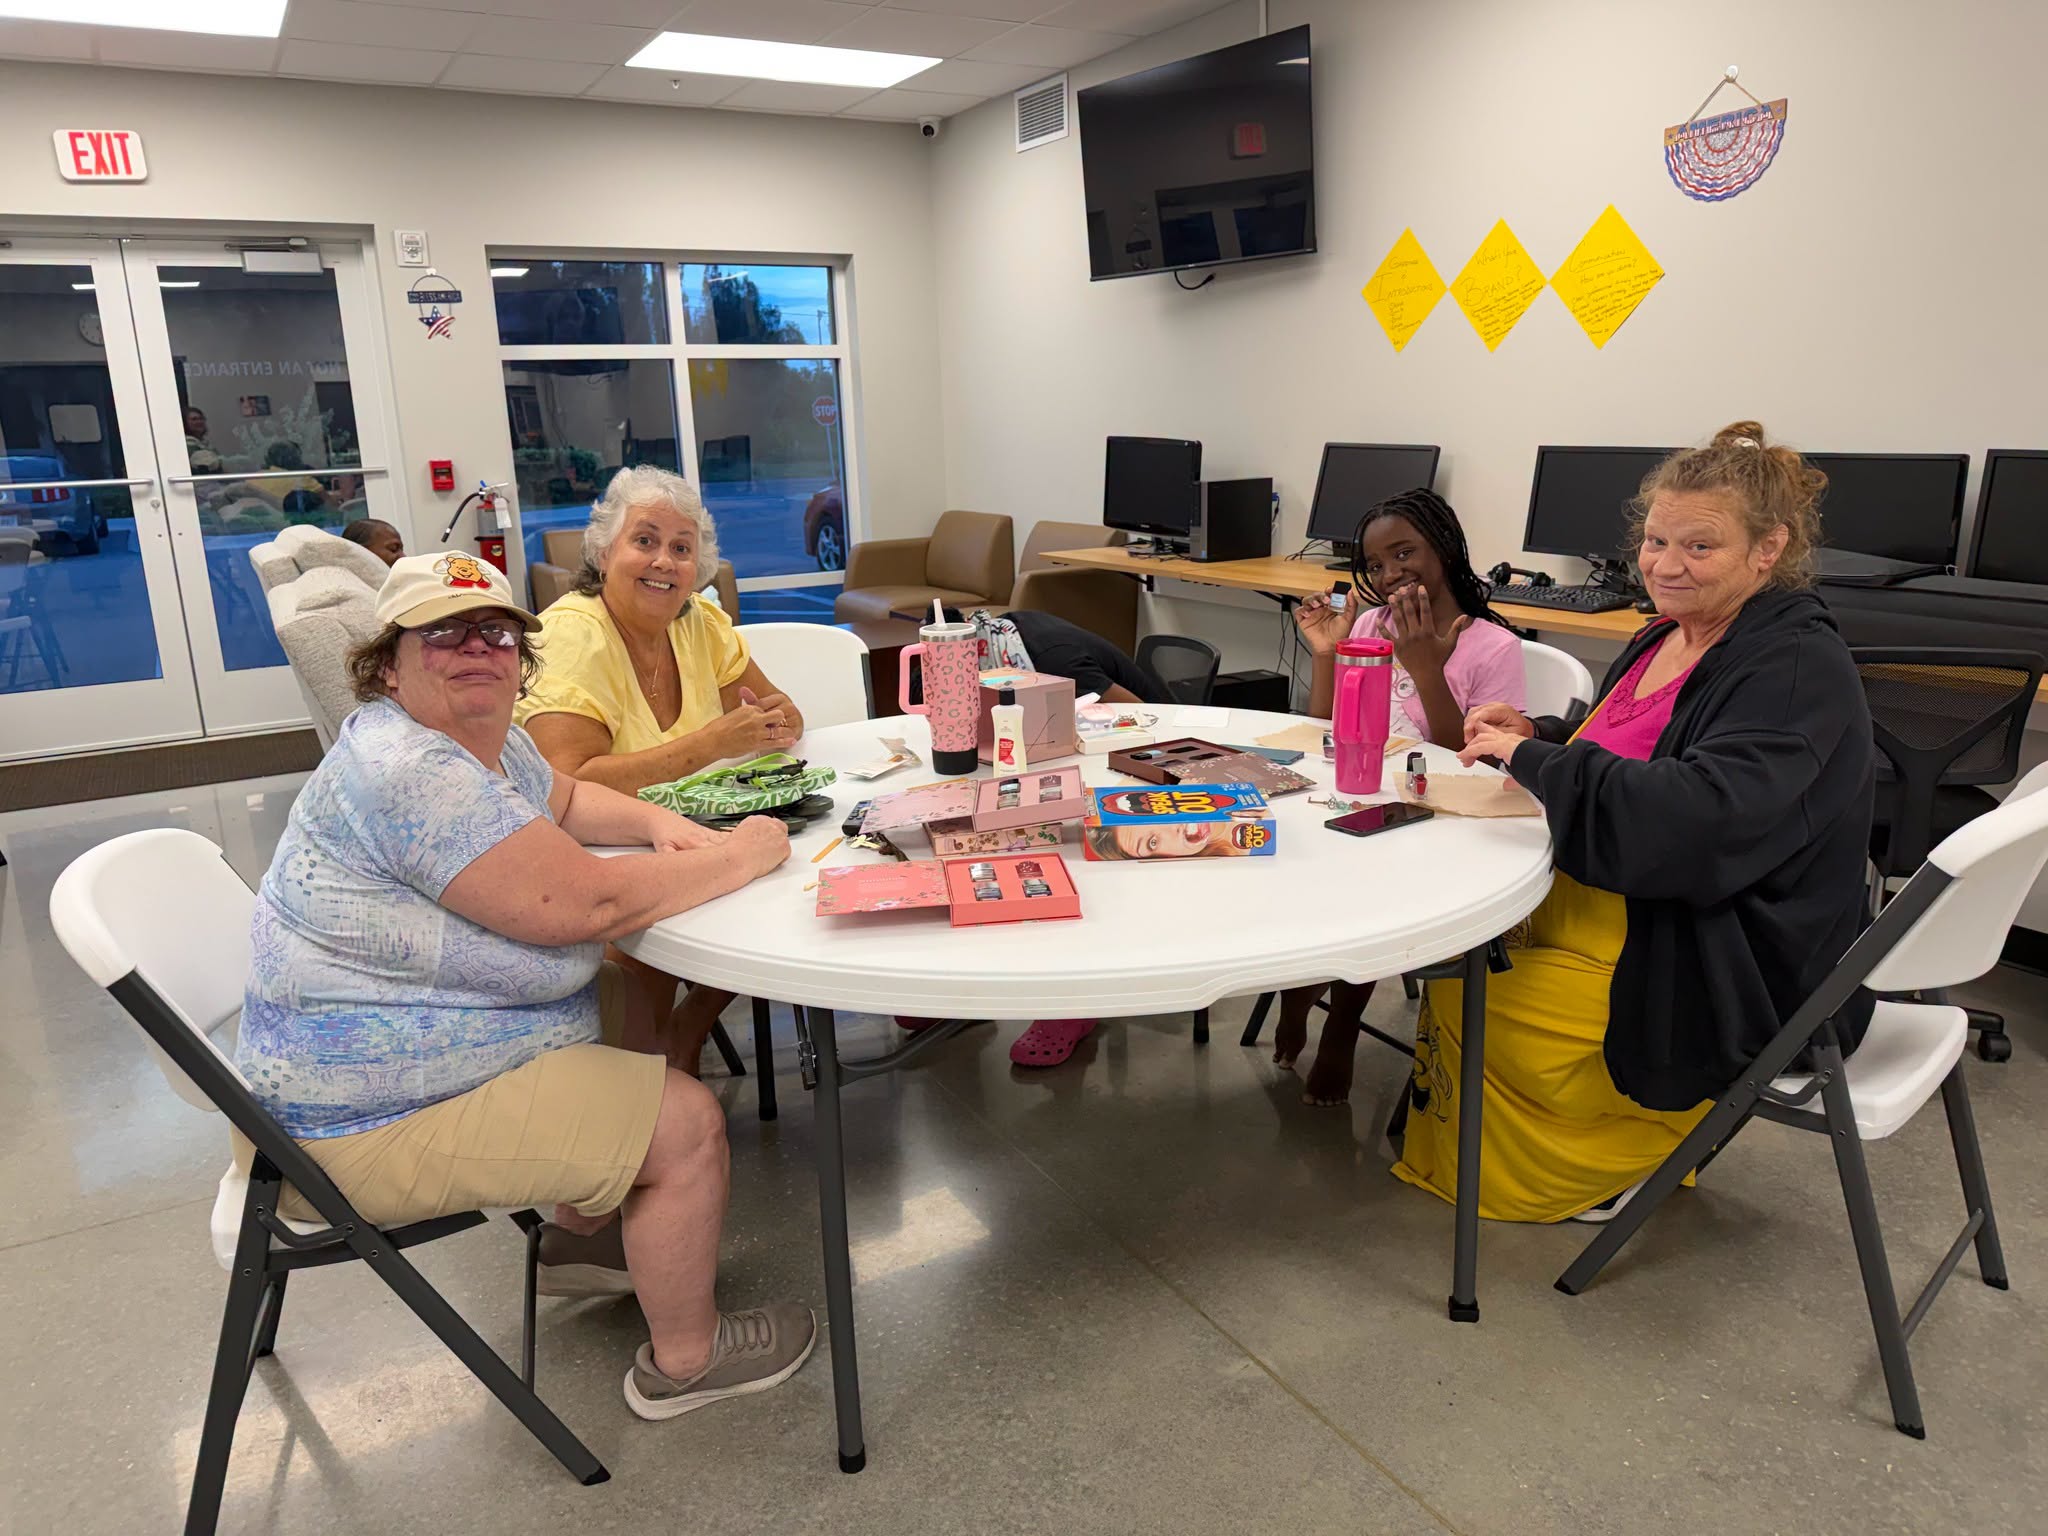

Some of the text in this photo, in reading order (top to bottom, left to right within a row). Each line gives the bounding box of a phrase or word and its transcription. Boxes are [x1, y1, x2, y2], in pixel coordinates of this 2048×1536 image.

[1674, 104, 1774, 142] AMERICA
[68, 131, 133, 175] EXIT
[815, 405, 835, 417] STOP
[1146, 791, 1176, 815] SPEAK
[1172, 790, 1218, 814] OUT
[1245, 824, 1266, 849] SPEAK OUT
